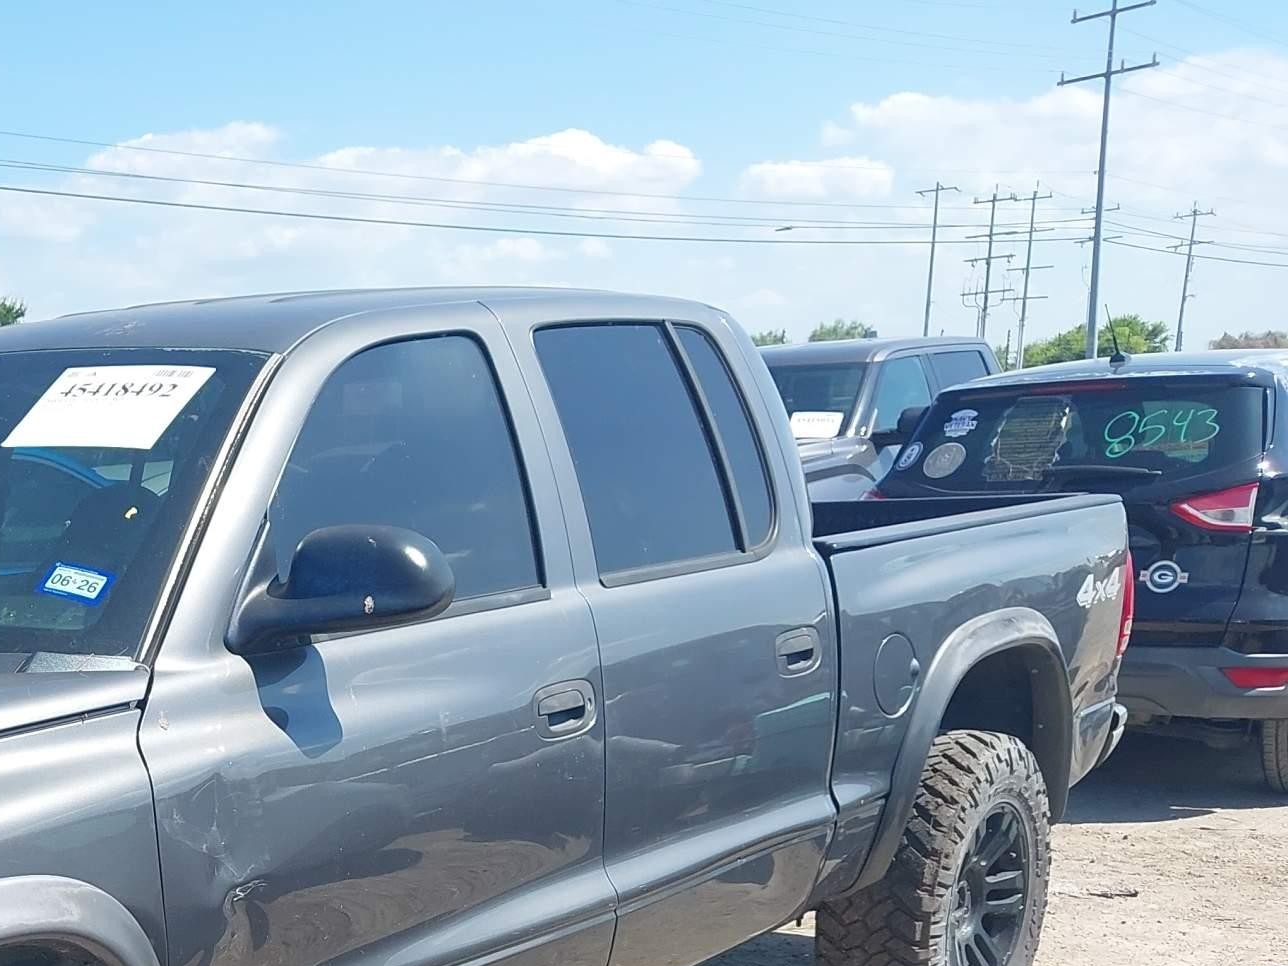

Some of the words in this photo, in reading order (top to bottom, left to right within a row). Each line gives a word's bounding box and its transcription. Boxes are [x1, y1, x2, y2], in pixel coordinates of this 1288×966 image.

[59, 382, 179, 397] 45418492
[1103, 408, 1220, 458] 8543
[50, 573, 73, 587] 06
[76, 579, 99, 593] 26
[1076, 566, 1121, 608] 4x4
